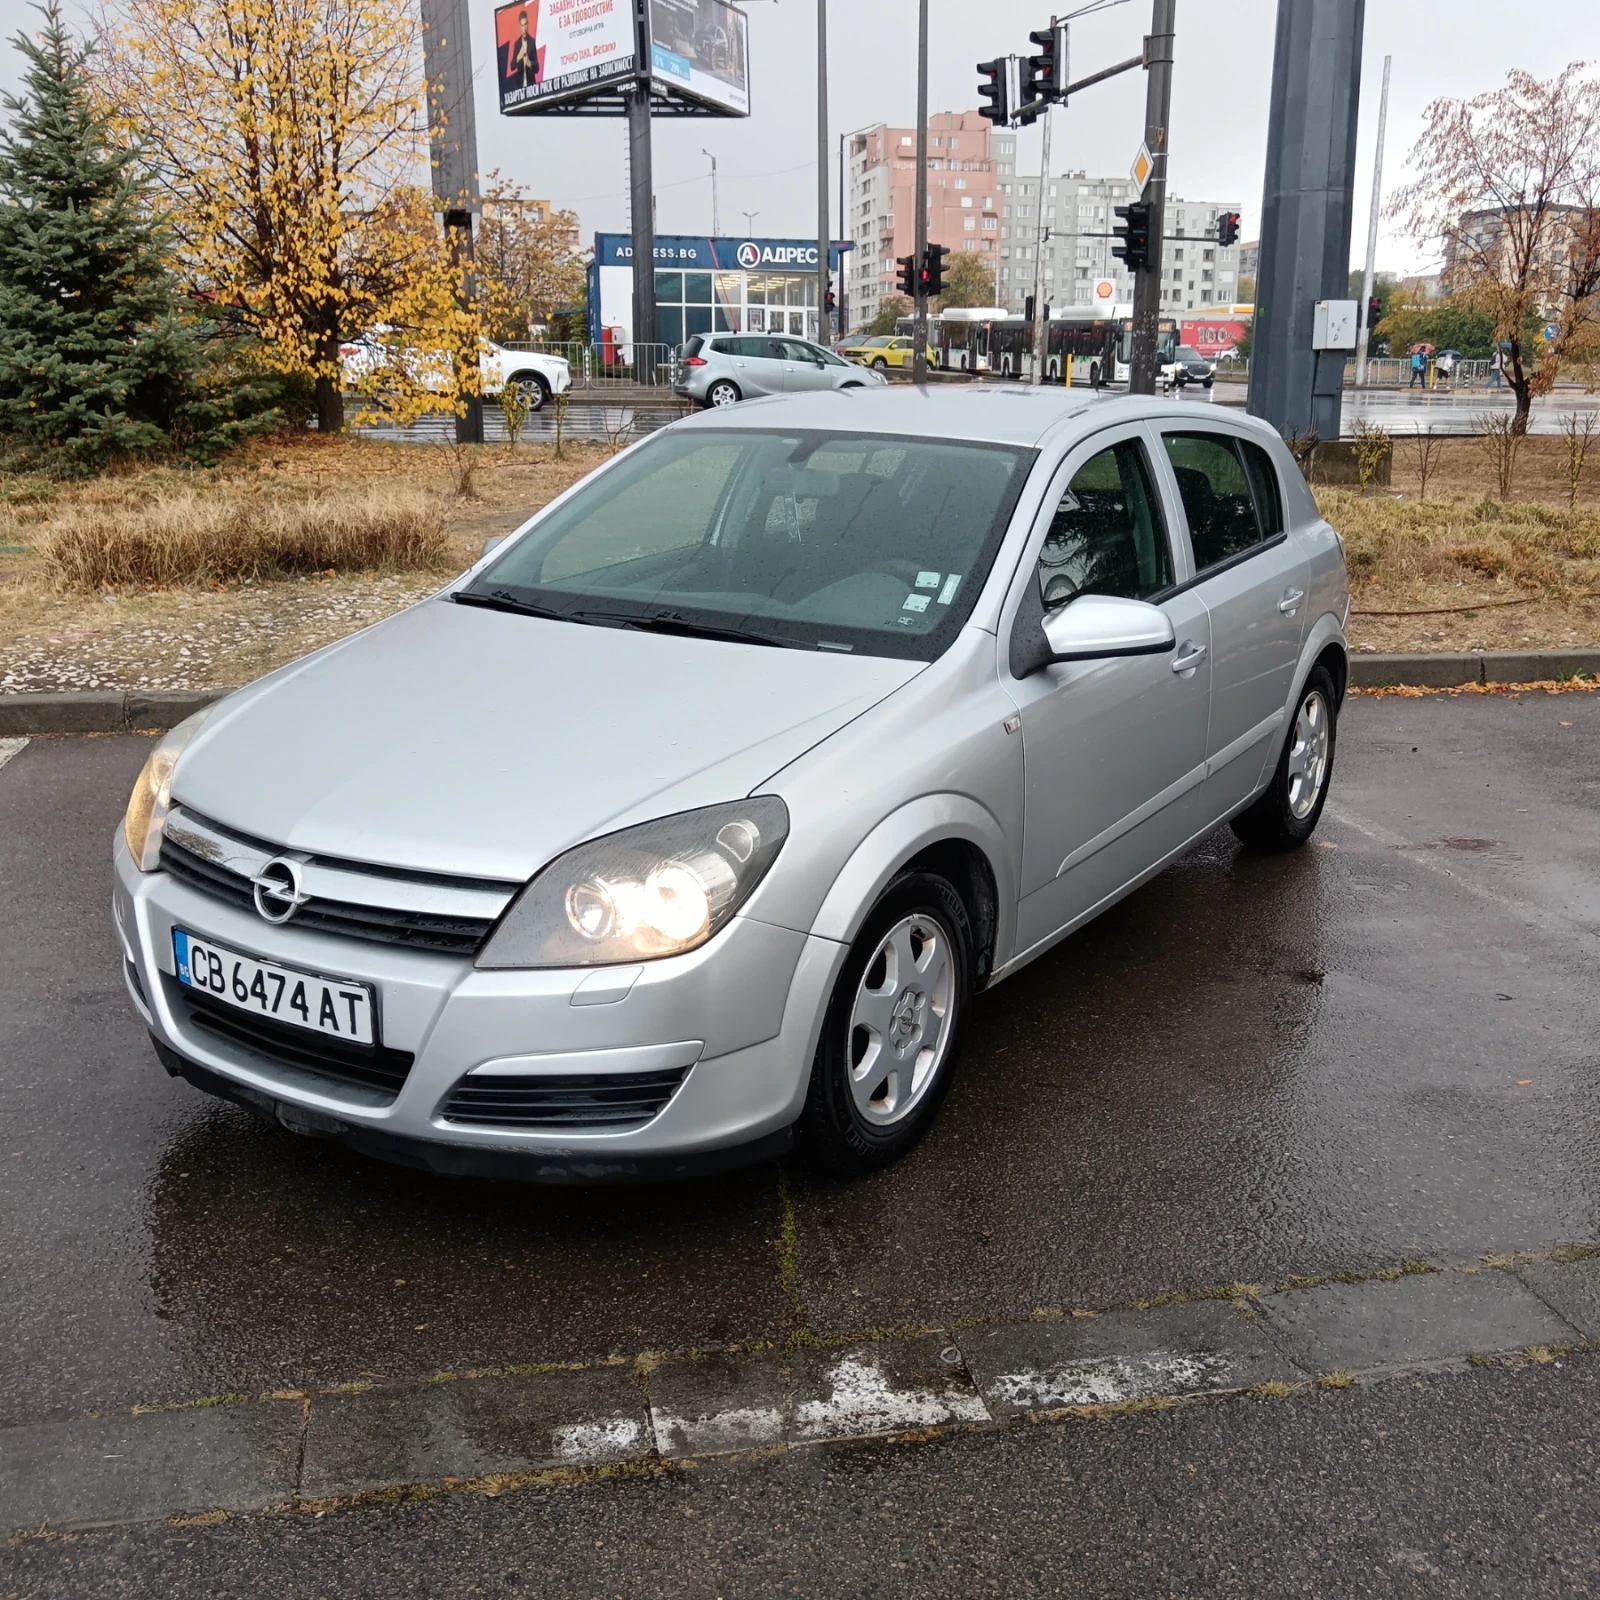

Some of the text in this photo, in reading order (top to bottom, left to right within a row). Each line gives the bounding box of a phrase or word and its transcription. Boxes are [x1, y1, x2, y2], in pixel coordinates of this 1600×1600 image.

[558, 0, 614, 28] Е ЗА УДОВОЛСТВИЕ
[560, 52, 579, 66] ТОЧНО
[593, 42, 617, 56] Betano
[504, 56, 634, 105] ХАЗАРТЪТ НОСИ РИСК ОТ РАЗВИВАНЕ НА ЗАВИСИМОСТ
[616, 247, 697, 259] ADESS.BG
[762, 247, 819, 264] АДРЕС
[179, 963, 190, 977] BG
[192, 945, 363, 1036] CB 6474 AT
